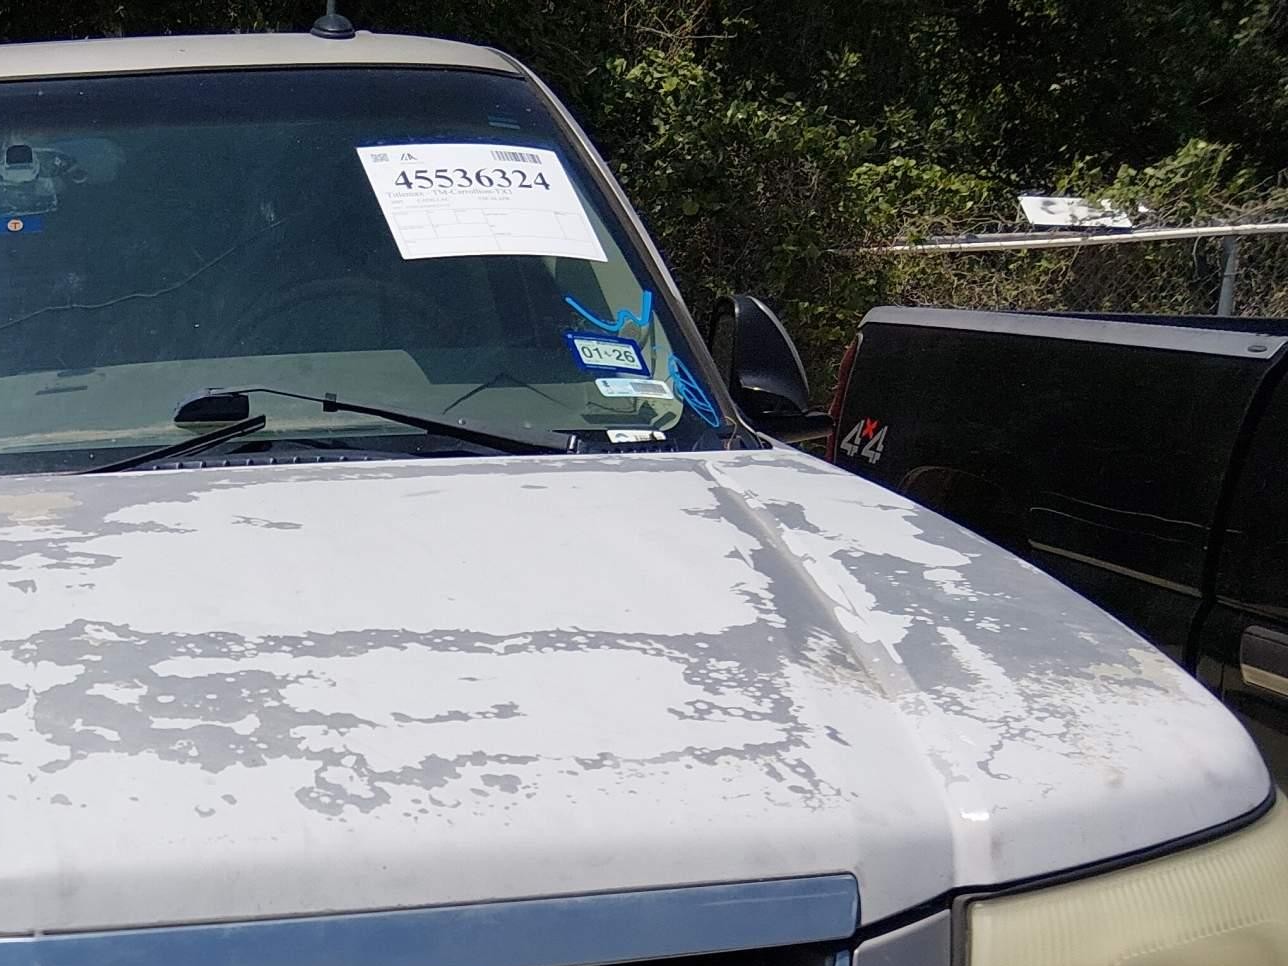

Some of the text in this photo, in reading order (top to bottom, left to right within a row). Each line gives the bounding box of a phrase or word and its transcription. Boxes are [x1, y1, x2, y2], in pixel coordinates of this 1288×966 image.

[394, 168, 551, 191] 45536324
[581, 345, 636, 364] 01 26
